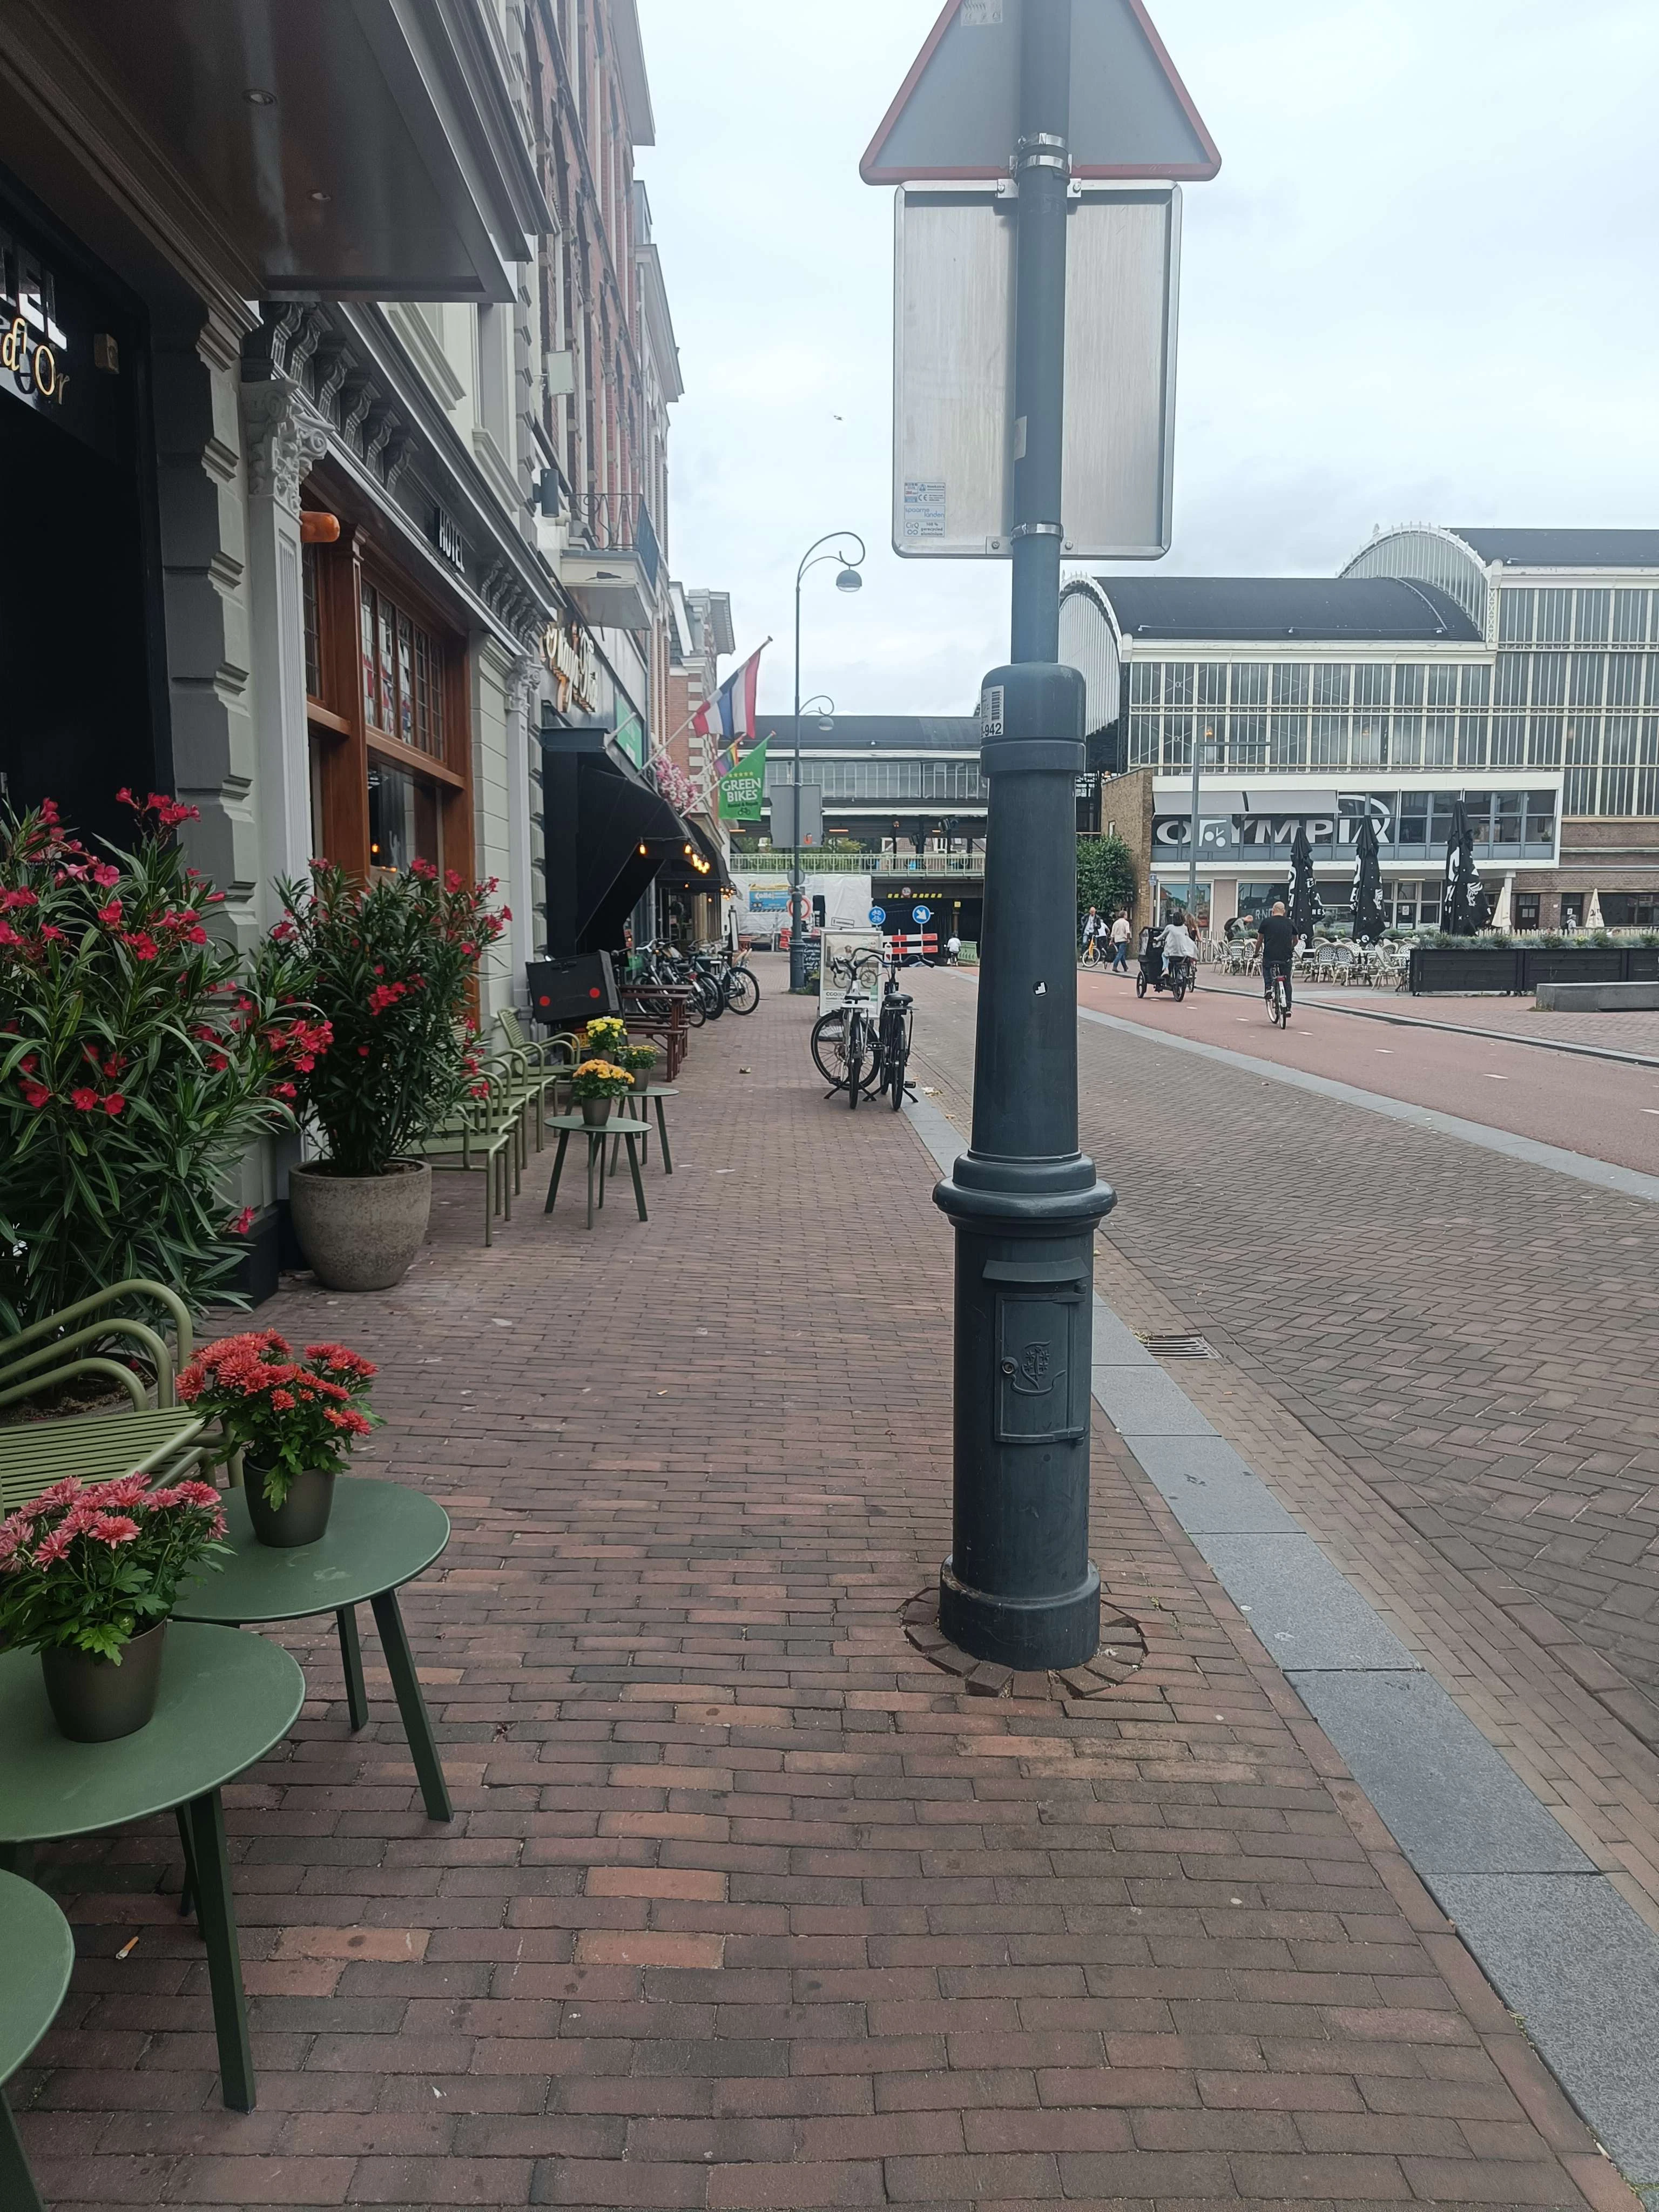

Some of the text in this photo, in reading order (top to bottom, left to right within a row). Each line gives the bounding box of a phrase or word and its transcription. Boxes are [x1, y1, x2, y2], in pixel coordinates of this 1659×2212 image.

[439, 507, 466, 573] HOTEL
[721, 778, 761, 791] GREEN
[727, 789, 757, 802] BIKES
[1156, 819, 1390, 845] OYMPIA
